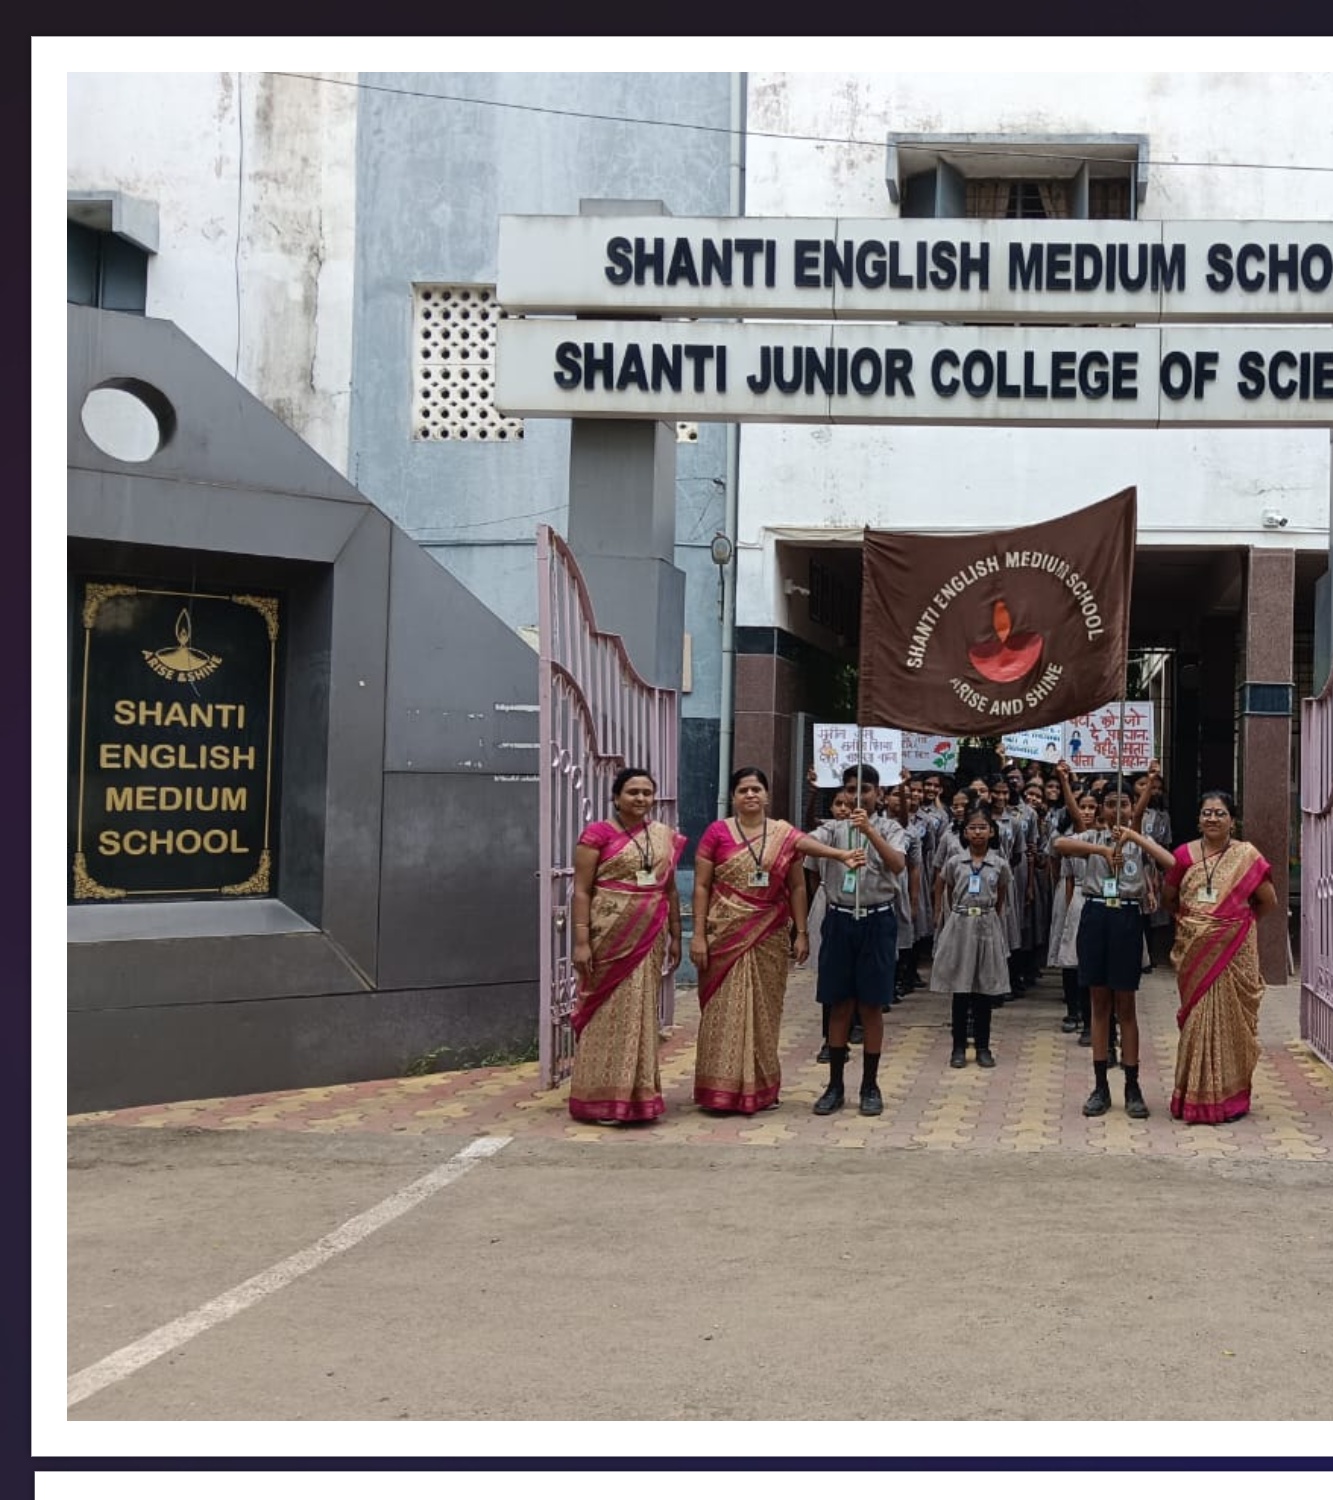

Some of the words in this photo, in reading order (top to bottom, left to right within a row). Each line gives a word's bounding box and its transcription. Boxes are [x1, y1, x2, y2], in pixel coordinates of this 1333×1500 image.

[605, 236, 776, 287] SHANTI
[794, 239, 990, 292] ENGLISH
[1008, 242, 1186, 292] MEDIUM
[554, 341, 727, 393] SHANTI
[746, 345, 915, 398] JUNIOR
[931, 349, 1139, 399] COLLEGE
[1160, 350, 1219, 400] OF
[907, 606, 942, 669] SHANTI
[933, 554, 1000, 610] ENGLISH
[1005, 550, 1070, 579] MEDIUM
[1064, 572, 1105, 642] SCHOOL
[141, 649, 175, 681] ARISE
[949, 676, 986, 713] ARISE
[989, 698, 1024, 716] AND
[1028, 662, 1064, 708] SHINE
[114, 699, 246, 730] SHANTI
[99, 743, 256, 771] ENGLISH
[105, 786, 248, 813] MEDIUM
[98, 829, 249, 856] SCHOOL
